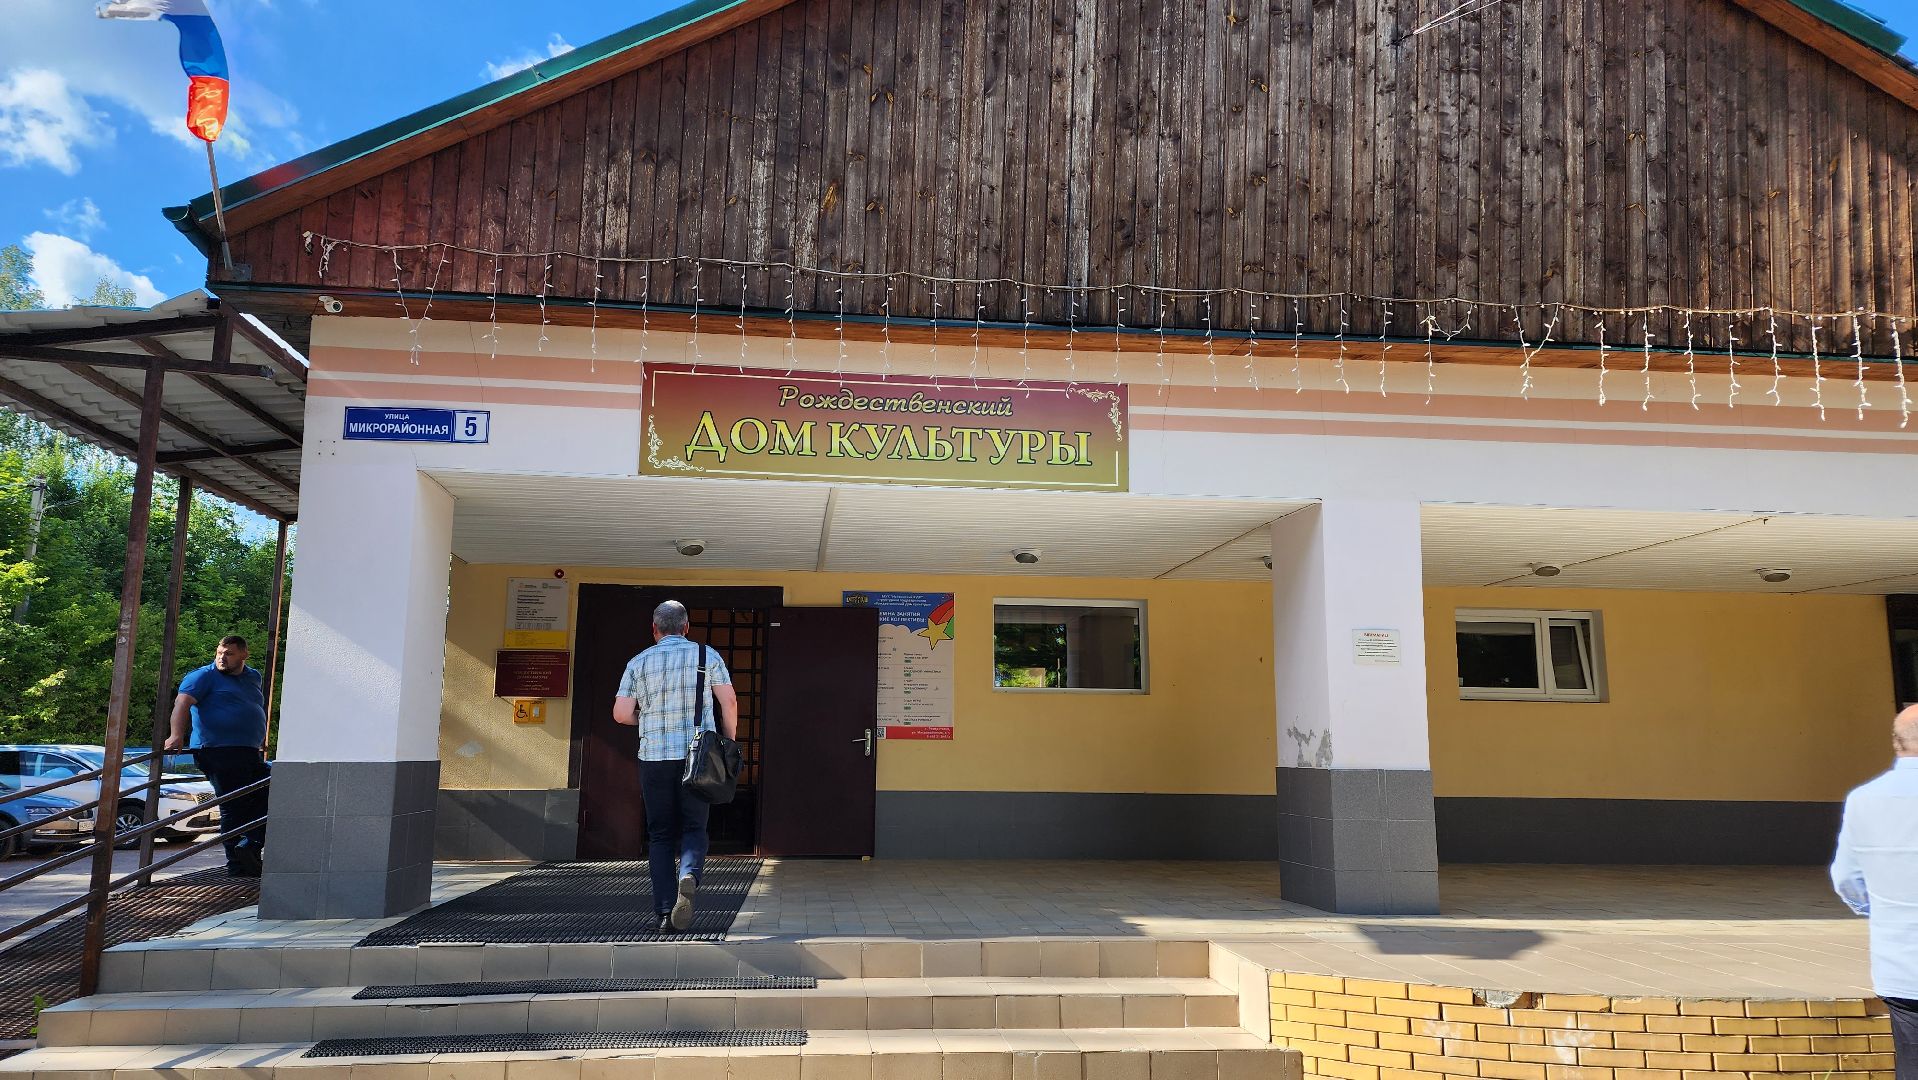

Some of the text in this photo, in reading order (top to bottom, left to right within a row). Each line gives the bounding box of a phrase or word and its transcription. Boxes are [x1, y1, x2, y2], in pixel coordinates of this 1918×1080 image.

[778, 385, 1013, 416] Рождественский
[349, 421, 449, 435] МИКРОРАЙОННАЯ
[465, 416, 477, 437] 5
[685, 411, 1092, 466] ДОМ КУЛЬТУРЫ
